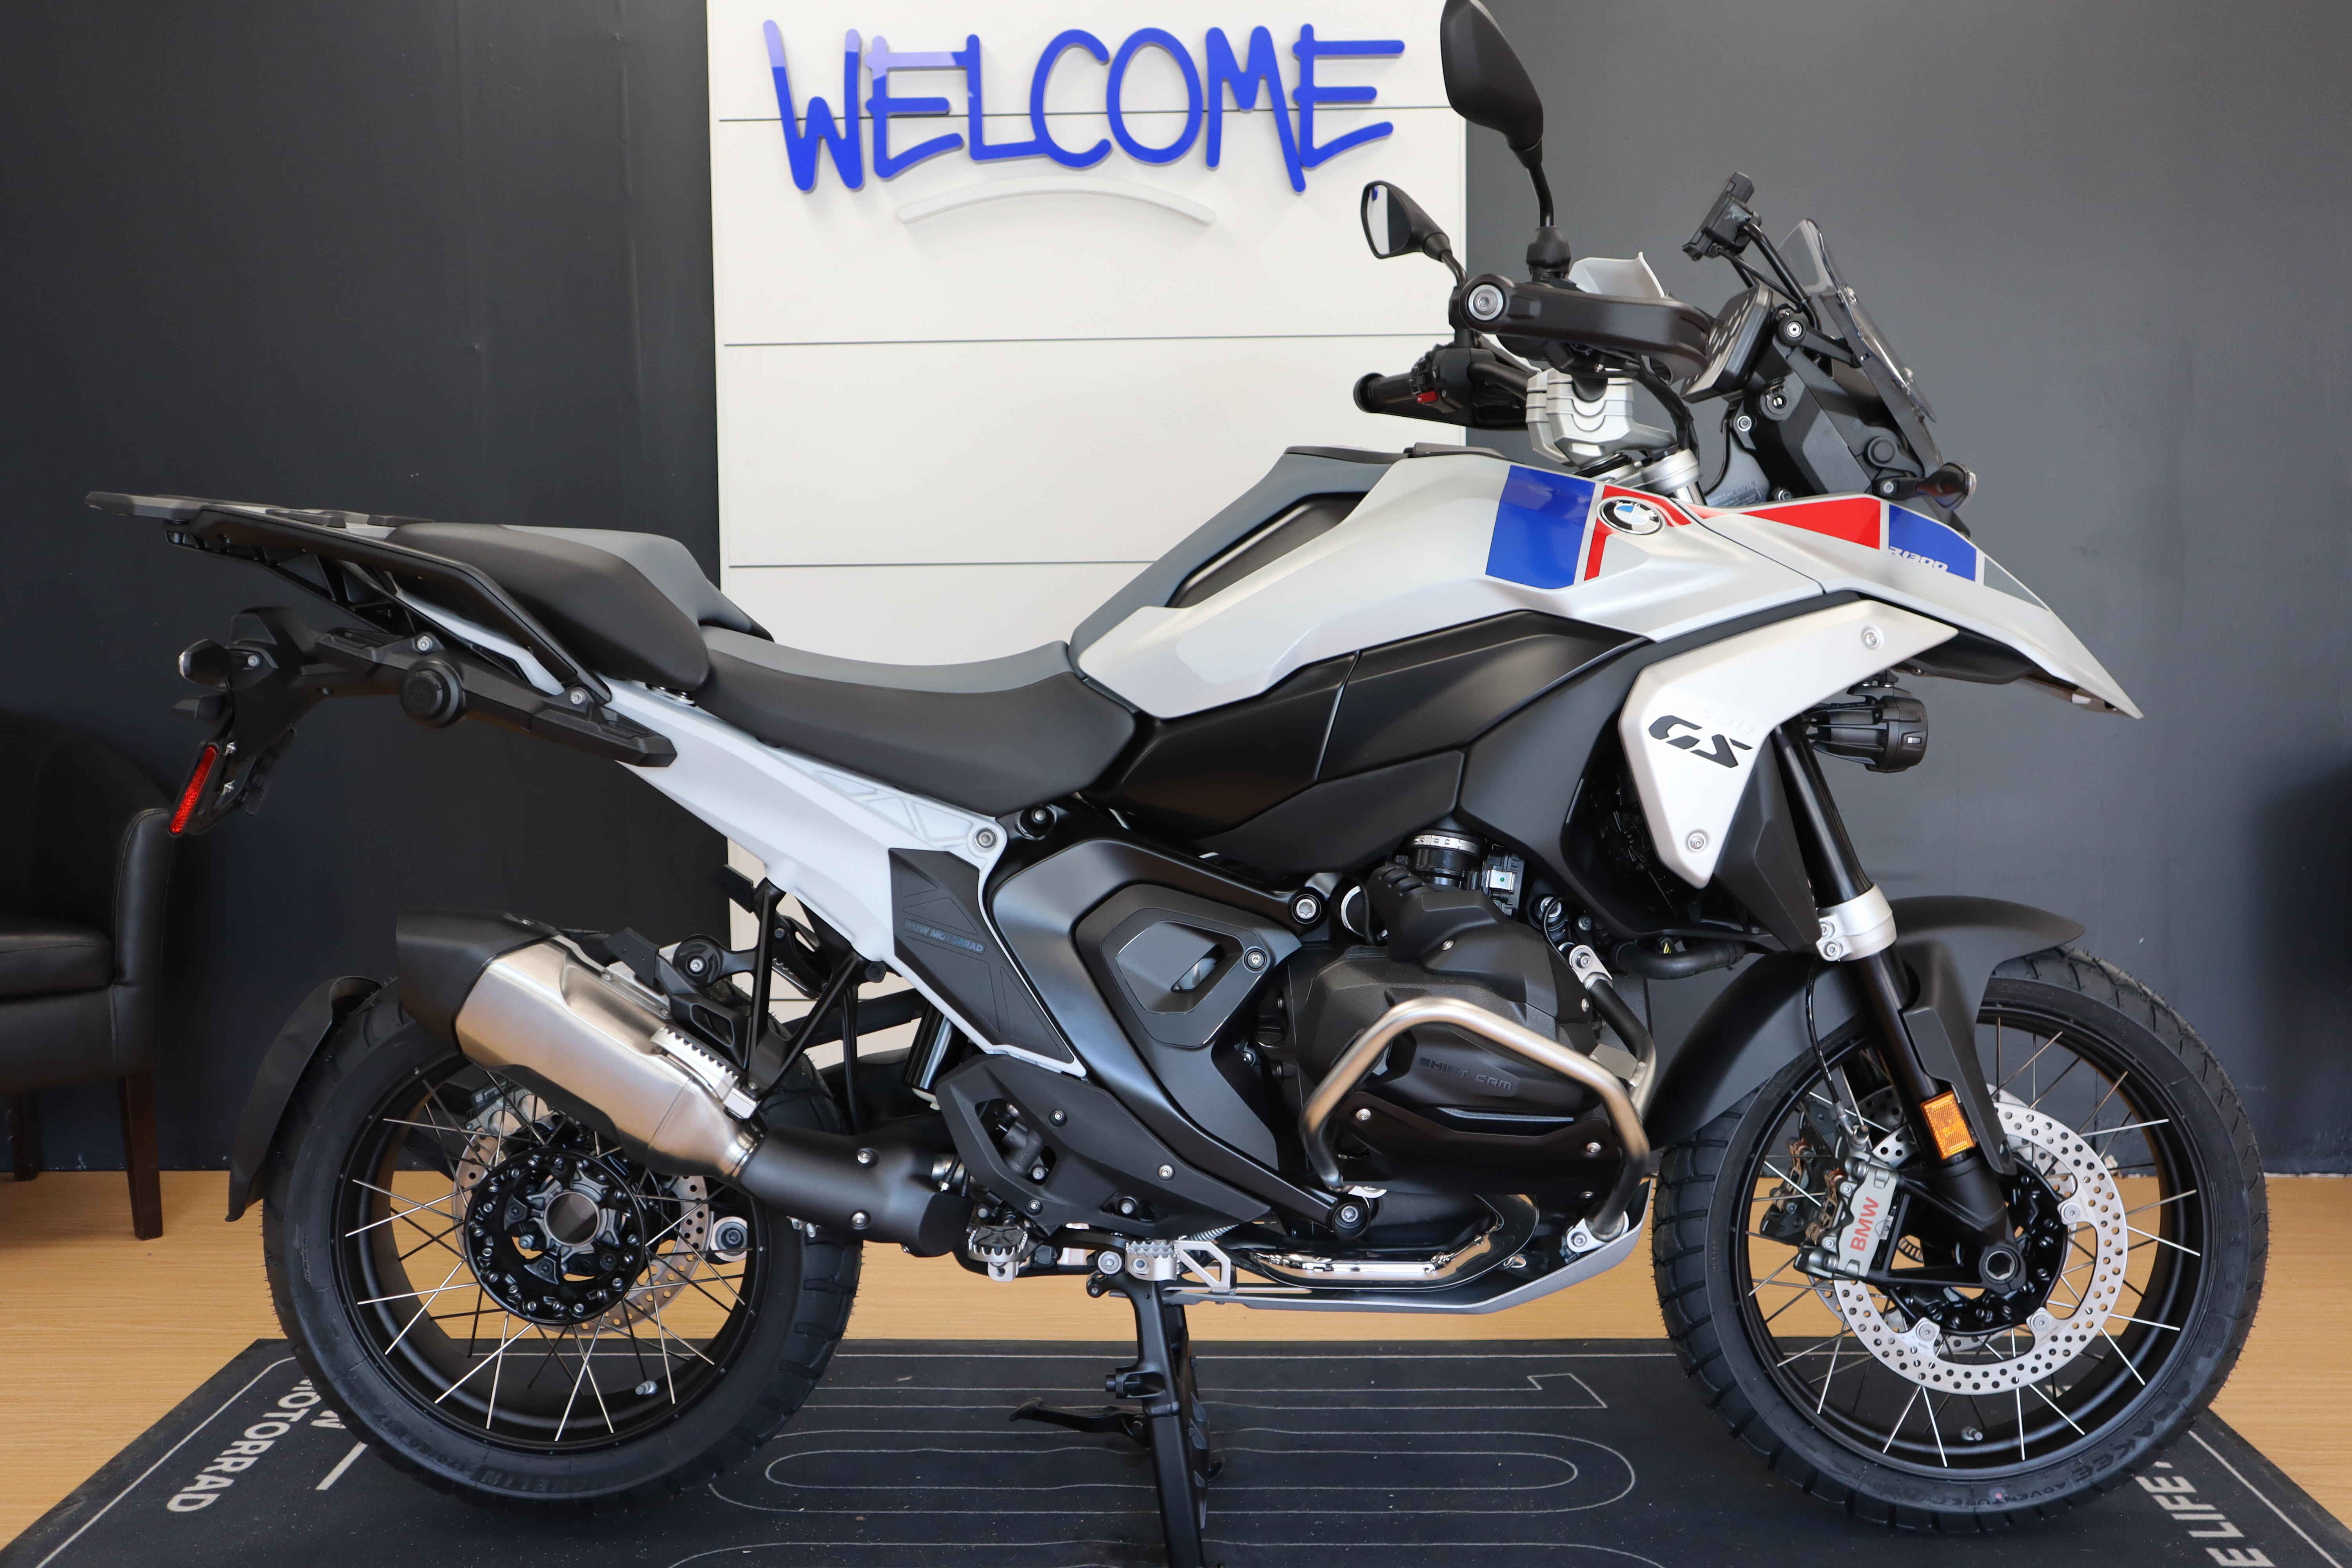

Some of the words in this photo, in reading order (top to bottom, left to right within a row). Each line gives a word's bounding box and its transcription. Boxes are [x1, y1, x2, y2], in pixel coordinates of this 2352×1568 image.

[762, 19, 1405, 194] WELCOME
[1648, 715, 1753, 768] GS
[906, 922, 929, 935] BMW
[930, 929, 983, 952] MOORRAD
[1419, 1057, 1469, 1078] SHIFT
[1475, 1073, 1513, 1090] CAM
[1850, 1196, 1879, 1252] BMW
[1951, 1480, 2067, 1506] ADVENTURE
[2135, 1476, 2244, 1537] LIFE
